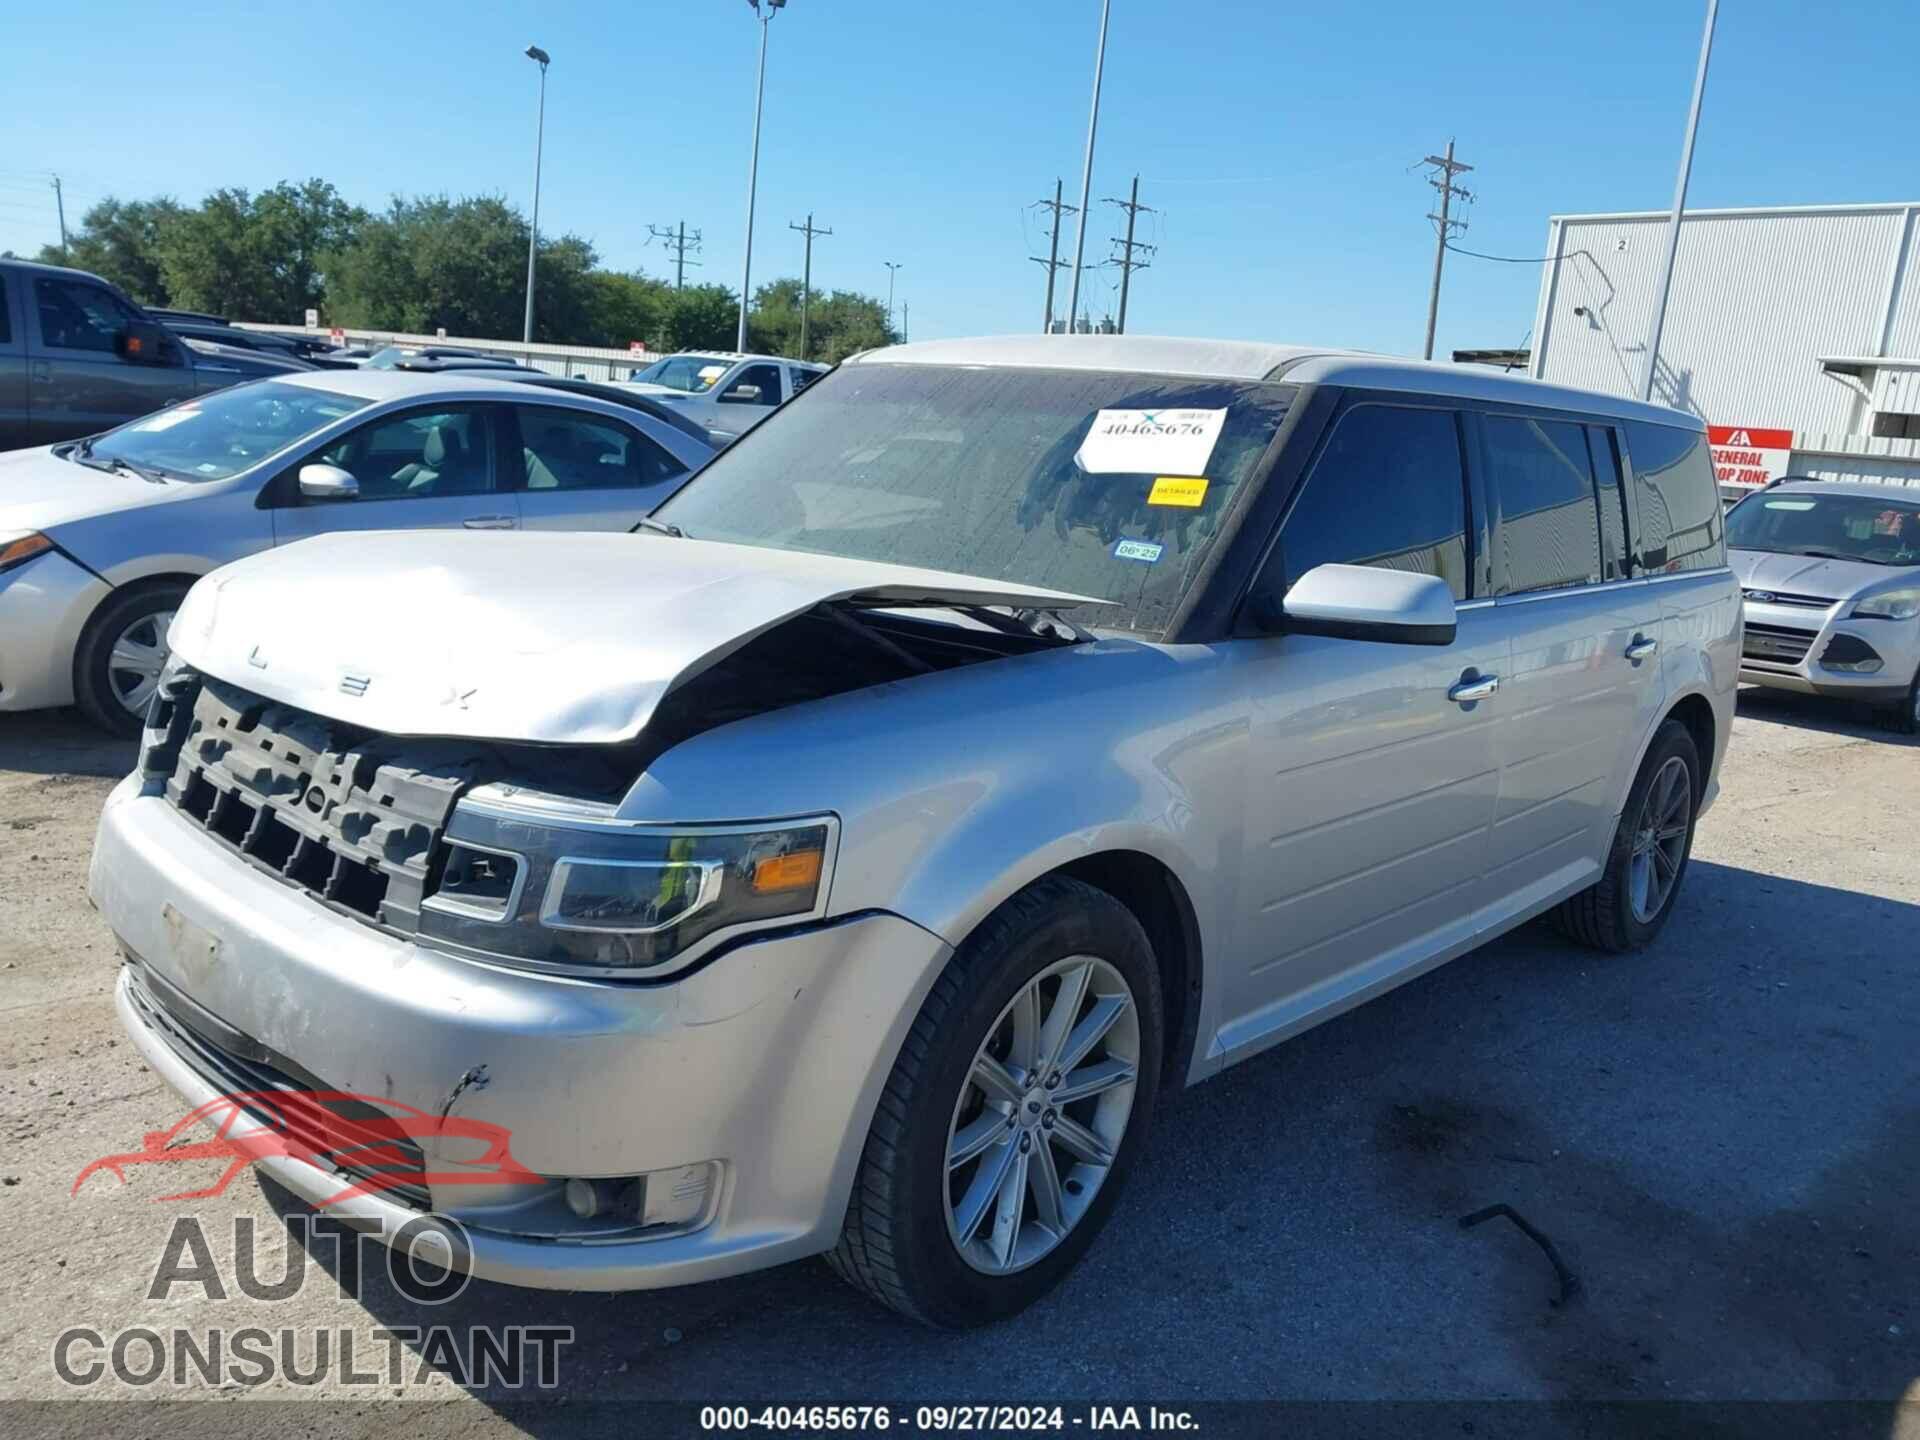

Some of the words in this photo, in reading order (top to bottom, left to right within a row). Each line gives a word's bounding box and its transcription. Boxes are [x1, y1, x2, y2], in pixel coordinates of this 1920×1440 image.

[1618, 240, 1626, 250] 2
[1711, 449, 1763, 467] GENERAL
[1736, 469, 1770, 484] ZONE
